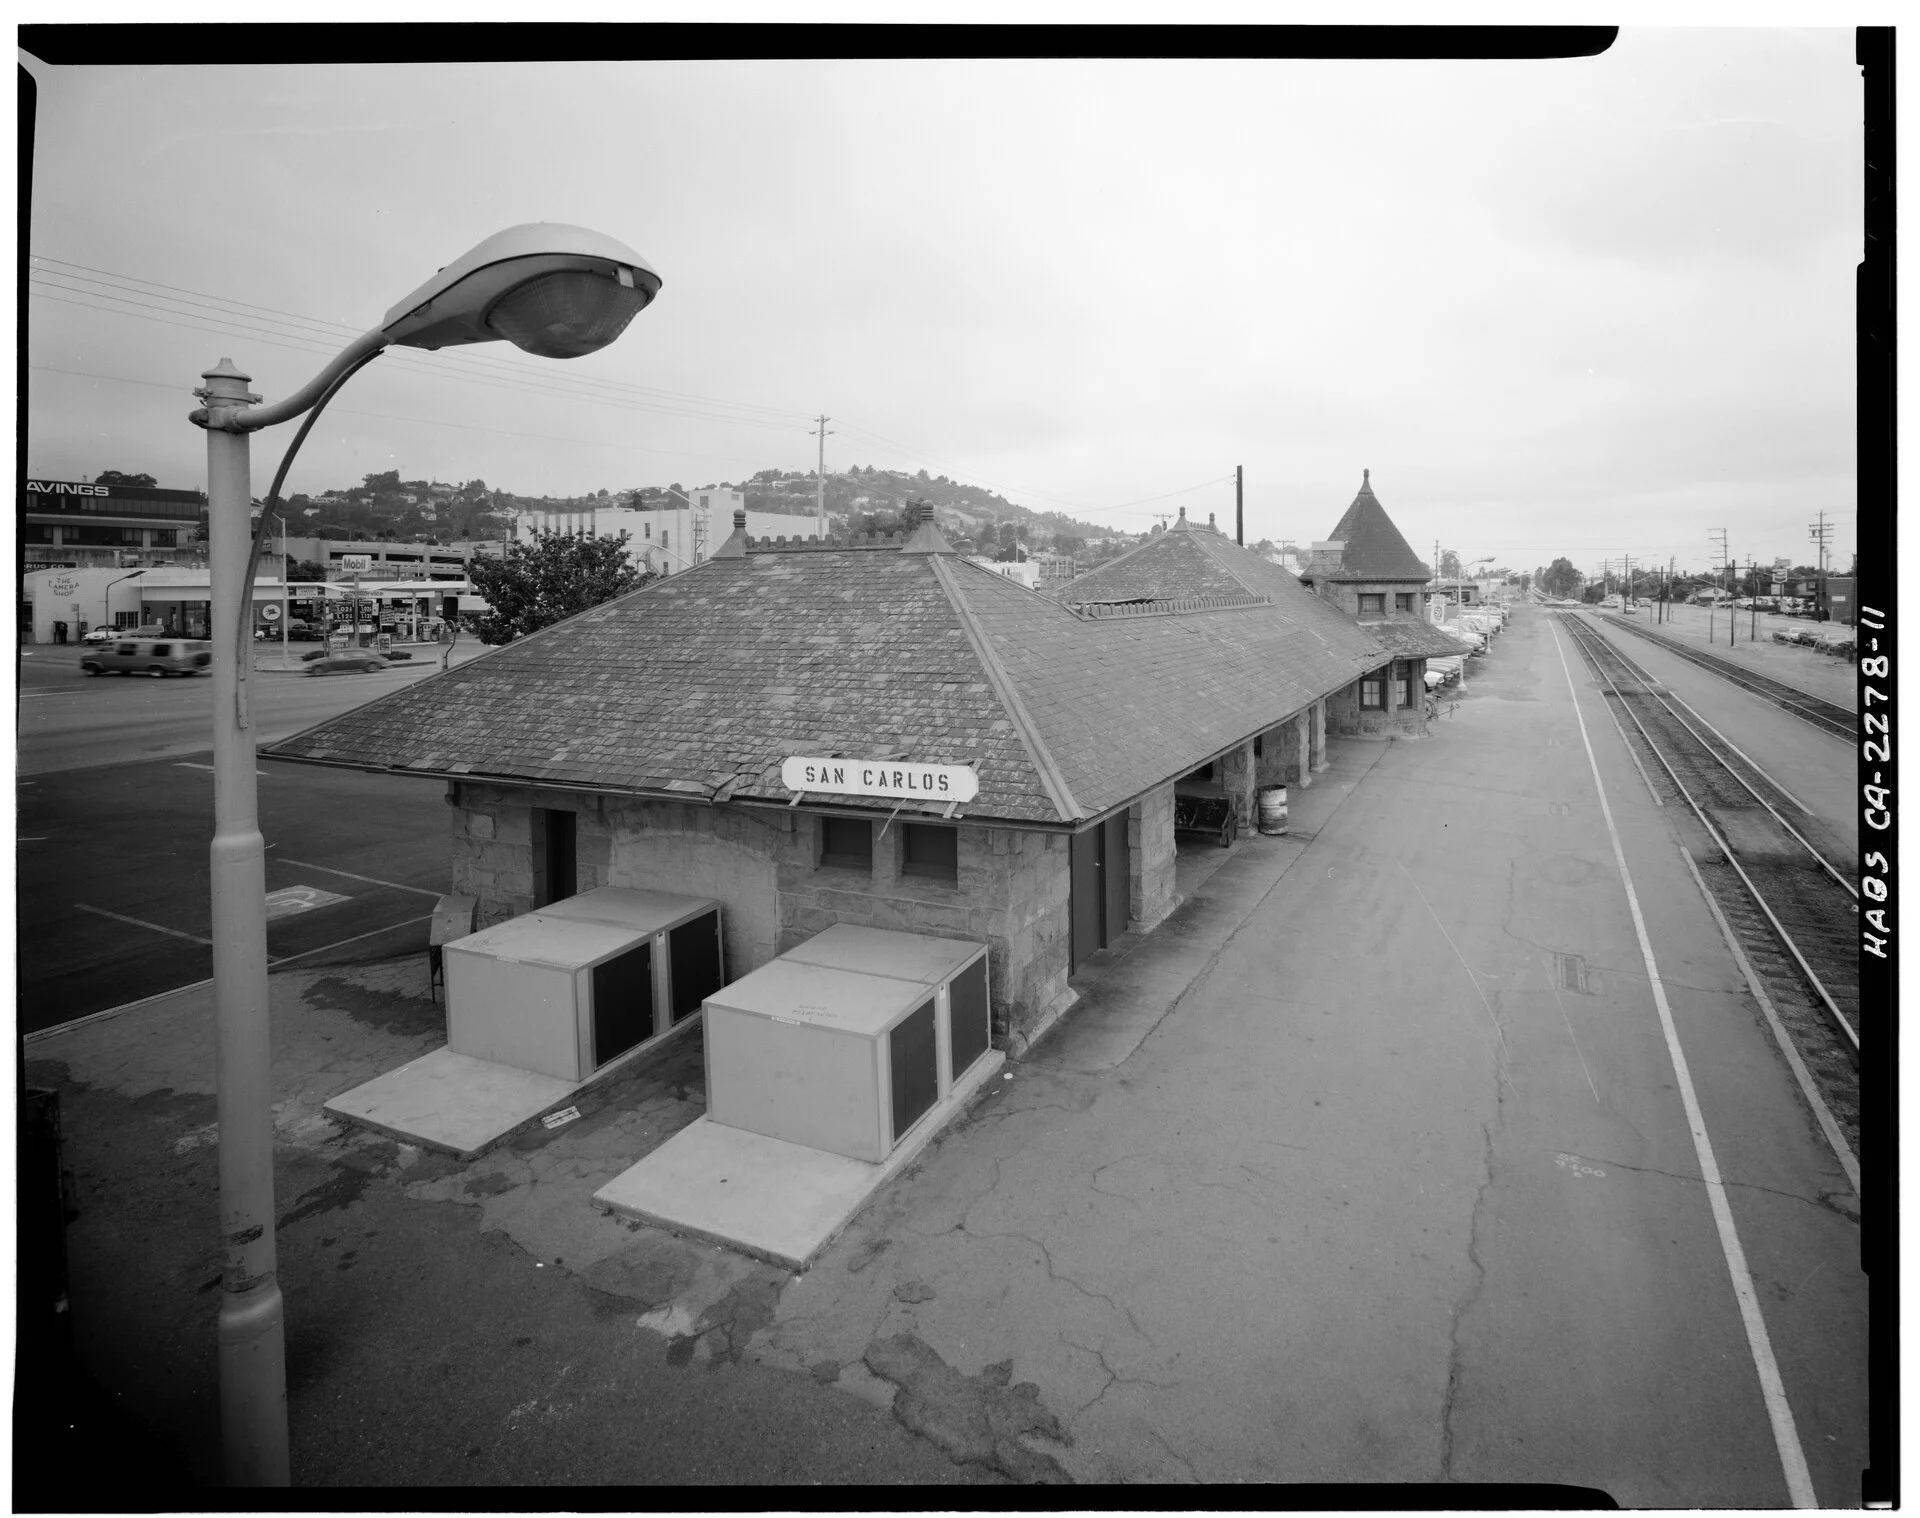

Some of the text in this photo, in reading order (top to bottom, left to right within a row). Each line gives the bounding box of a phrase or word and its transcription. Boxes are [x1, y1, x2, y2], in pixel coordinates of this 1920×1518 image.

[343, 558, 366, 569] Mobil
[48, 579, 80, 590] CAMERA
[53, 589, 74, 597] SHOP
[805, 766, 949, 791] SAN CARLOS
